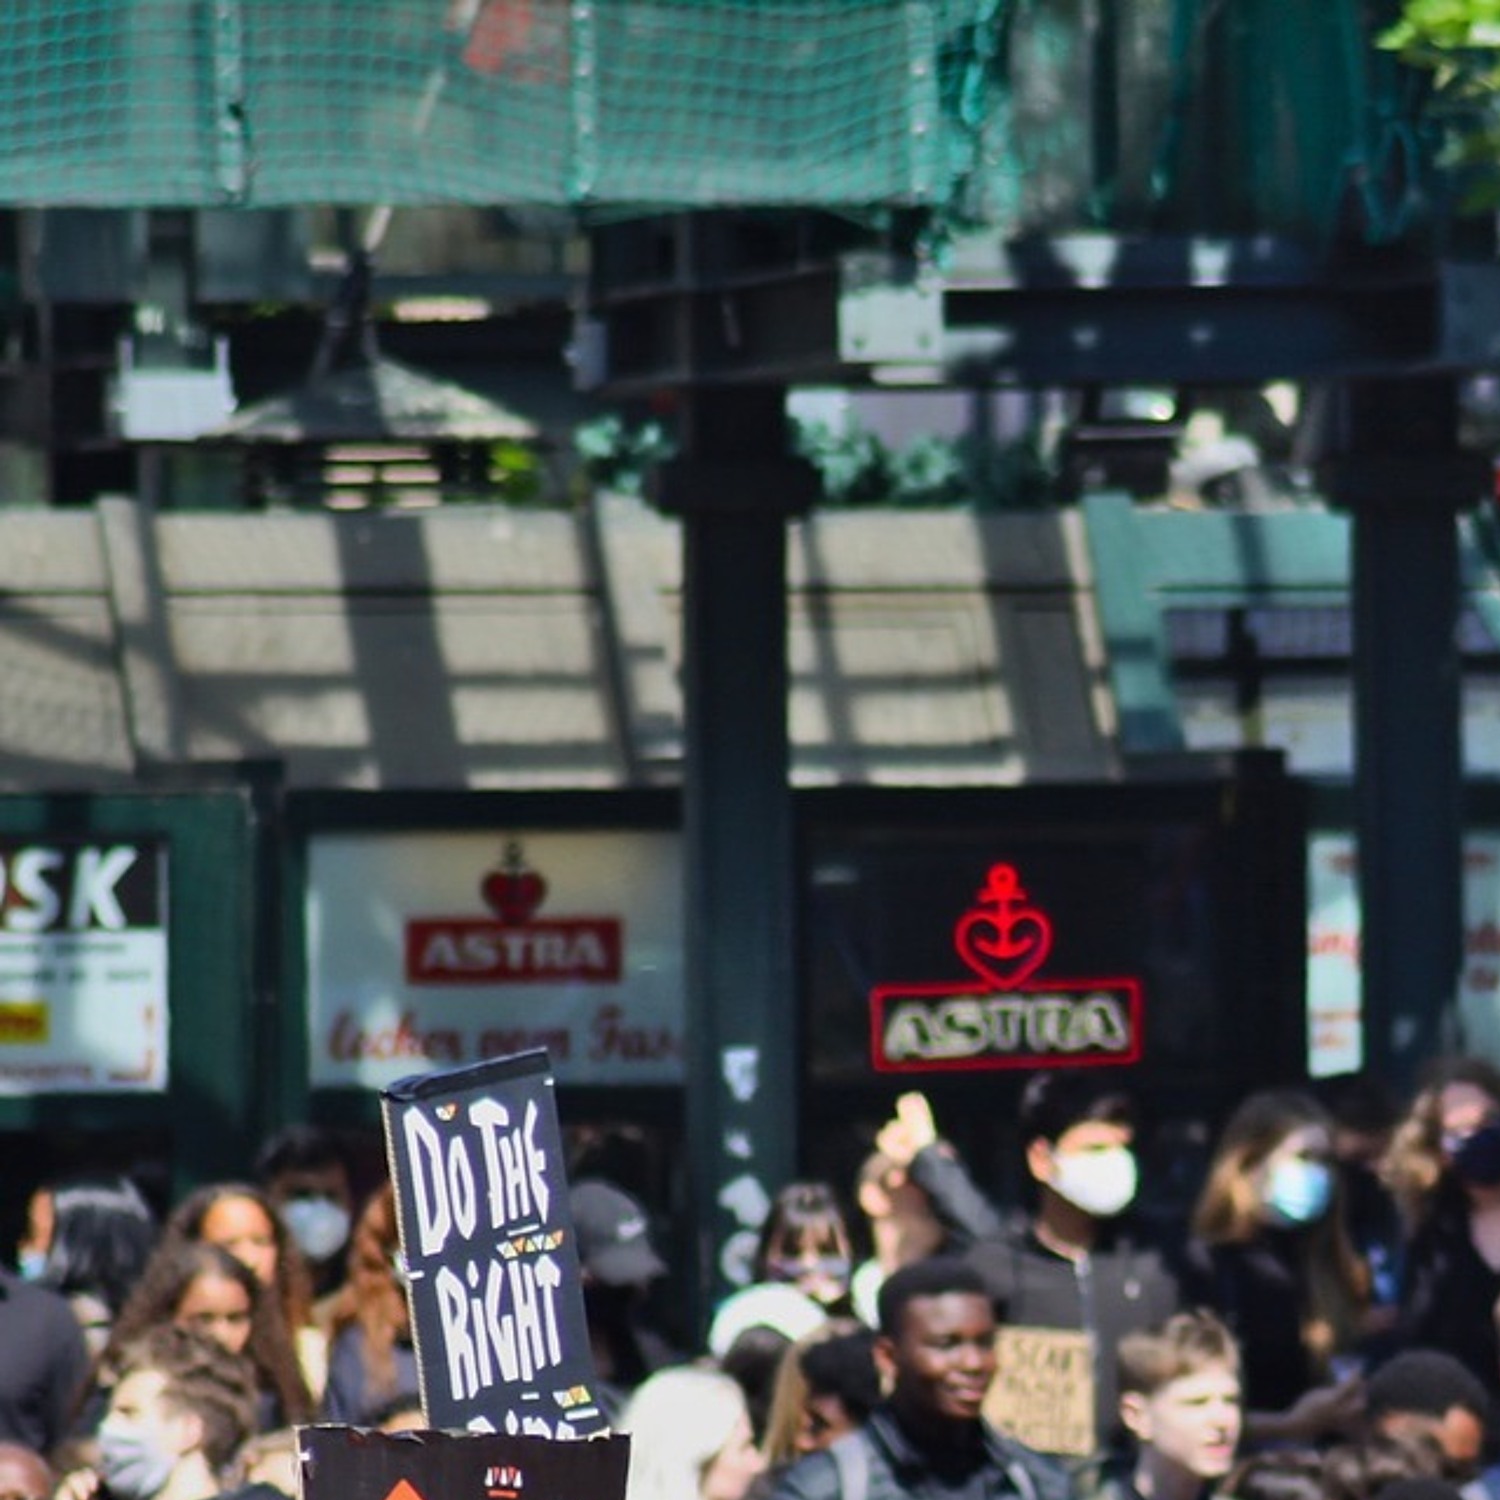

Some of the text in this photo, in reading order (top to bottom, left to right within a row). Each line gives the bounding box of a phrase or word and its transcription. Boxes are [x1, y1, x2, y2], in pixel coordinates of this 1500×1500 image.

[0, 845, 138, 931] SK
[418, 936, 608, 971] ASTRA
[884, 992, 1130, 1061] ASTRA
[468, 1097, 550, 1229] THE
